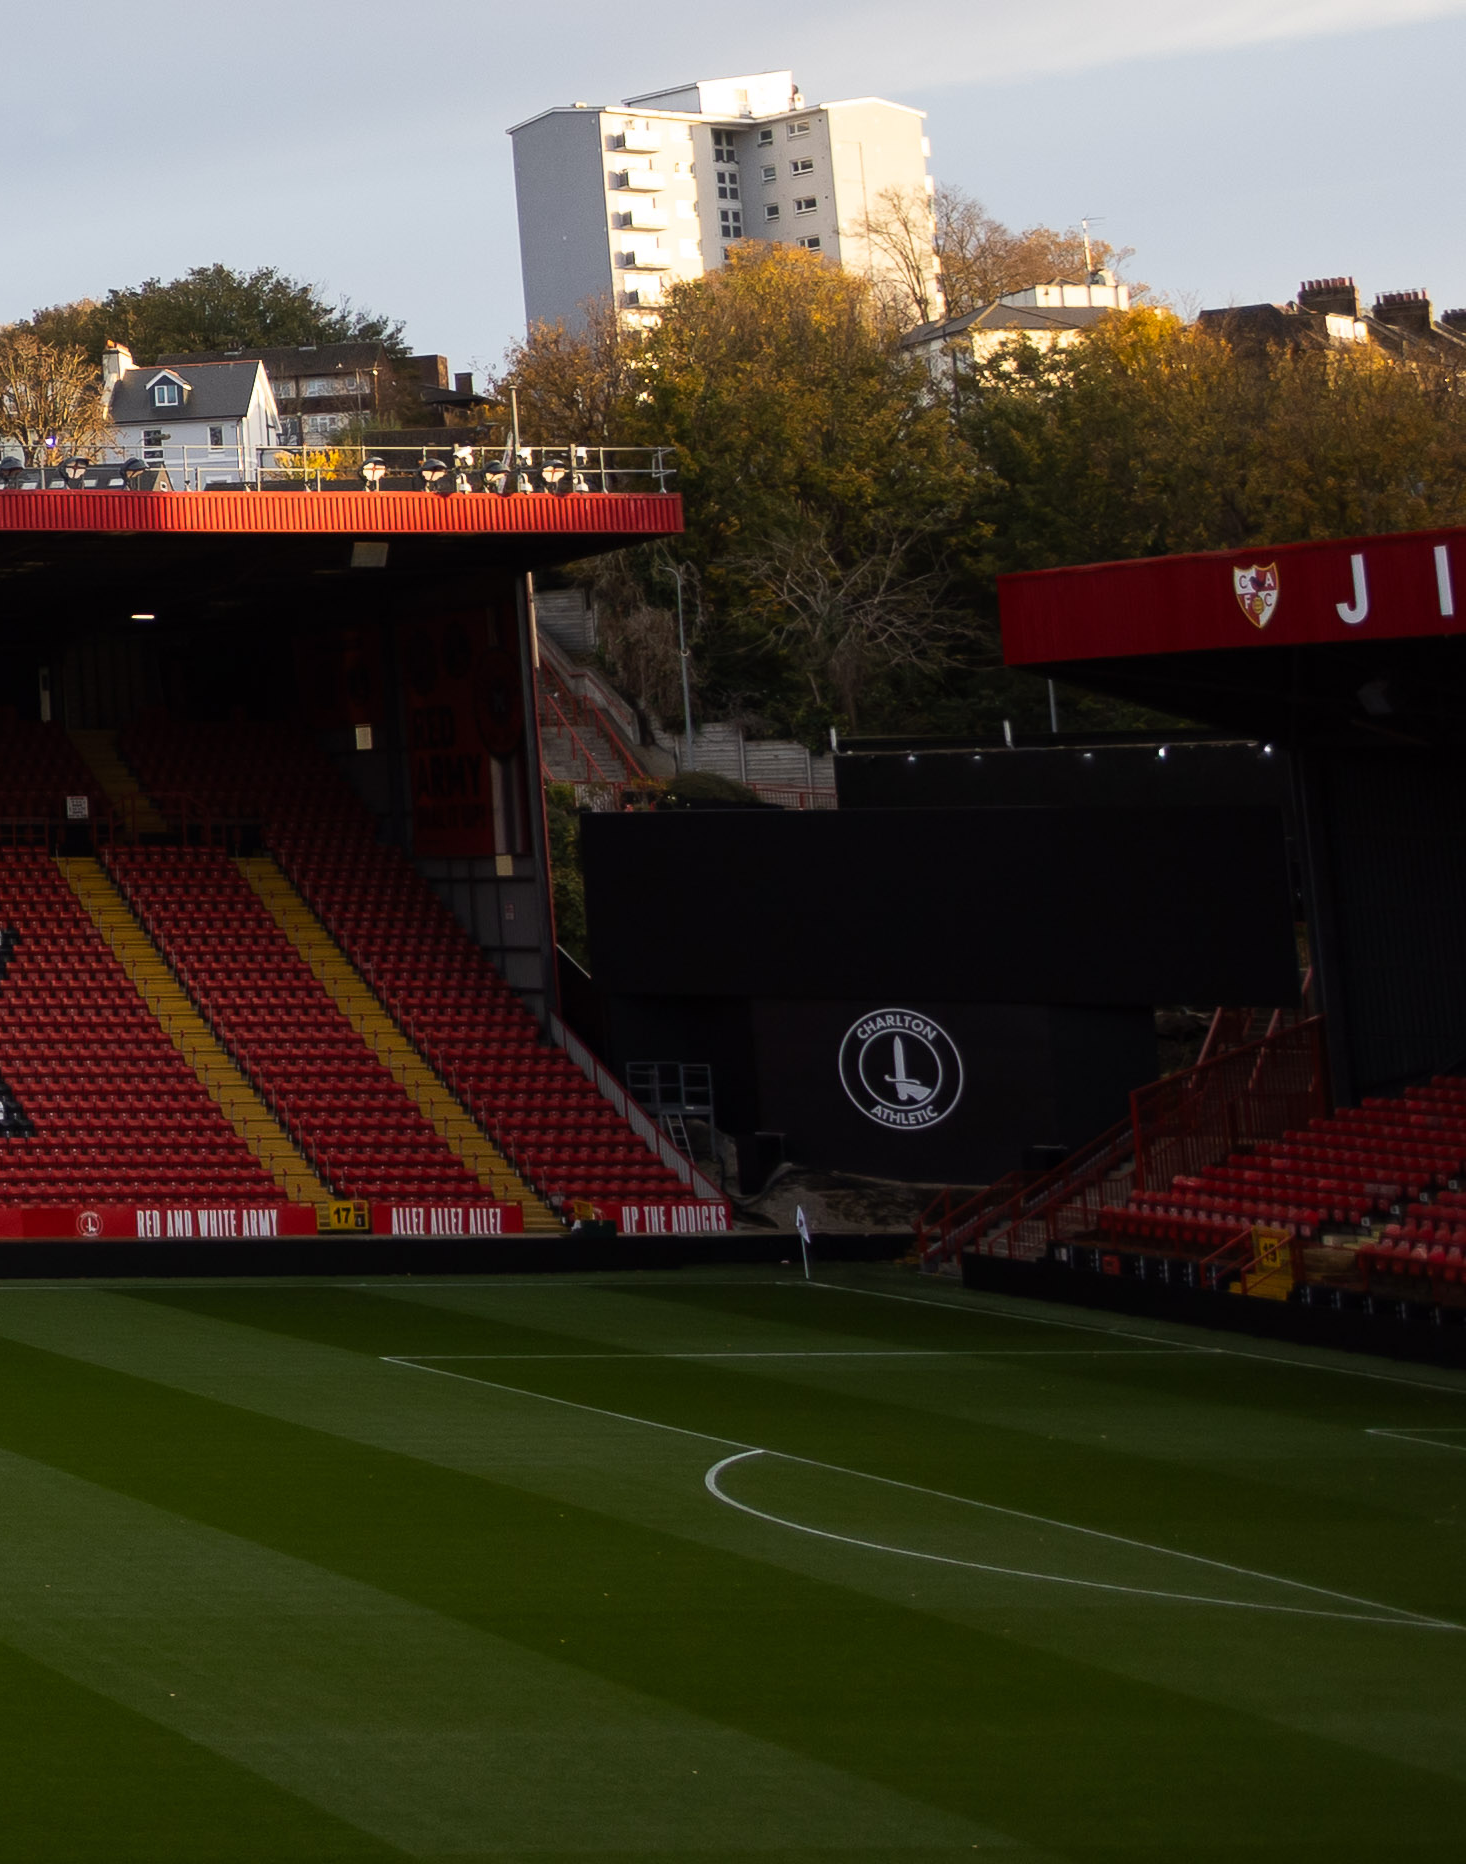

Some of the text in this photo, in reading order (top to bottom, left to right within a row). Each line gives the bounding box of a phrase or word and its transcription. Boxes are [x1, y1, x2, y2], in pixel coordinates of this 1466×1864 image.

[856, 1014, 938, 1041] CHARLTON
[870, 1104, 939, 1125] ATHLETIC
[137, 1210, 276, 1237] RED AND WHITE ARMY
[333, 1208, 351, 1223] 17
[393, 1208, 501, 1235] ALLEZ ALLEZ ALLEZ
[622, 1206, 726, 1235] UP THE ADDICKS
